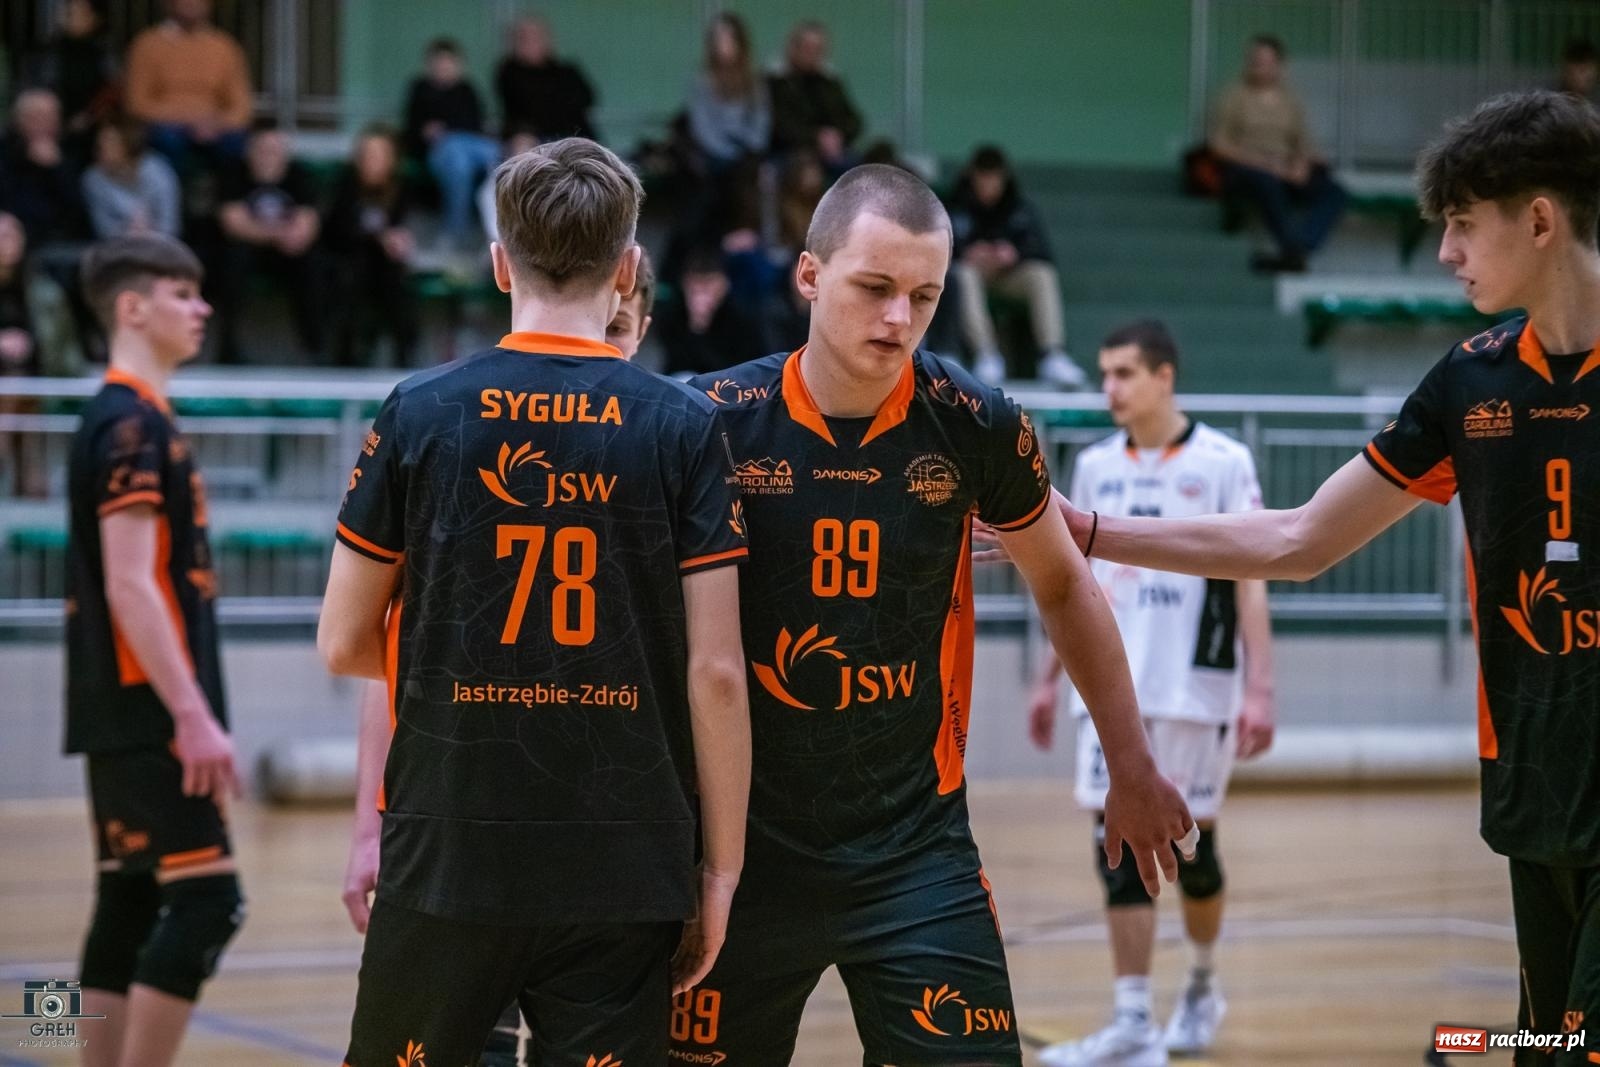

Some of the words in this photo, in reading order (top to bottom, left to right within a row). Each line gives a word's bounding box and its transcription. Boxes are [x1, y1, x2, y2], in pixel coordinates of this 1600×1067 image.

[480, 388, 623, 425] SYGUŁA
[736, 385, 770, 404] JSW
[543, 472, 618, 508] JSW
[759, 487, 794, 495] BIELSKO
[812, 469, 871, 482] DAMONS
[1546, 458, 1572, 540] 9
[811, 518, 880, 598] 89
[496, 524, 597, 646] 78
[1559, 609, 1600, 656] JS
[453, 681, 639, 711] Jastrzębie-Zdrój
[835, 660, 917, 711] JSW
[671, 988, 721, 1045] 89
[962, 1008, 1011, 1036] JSW
[668, 1049, 714, 1064] AMONS
